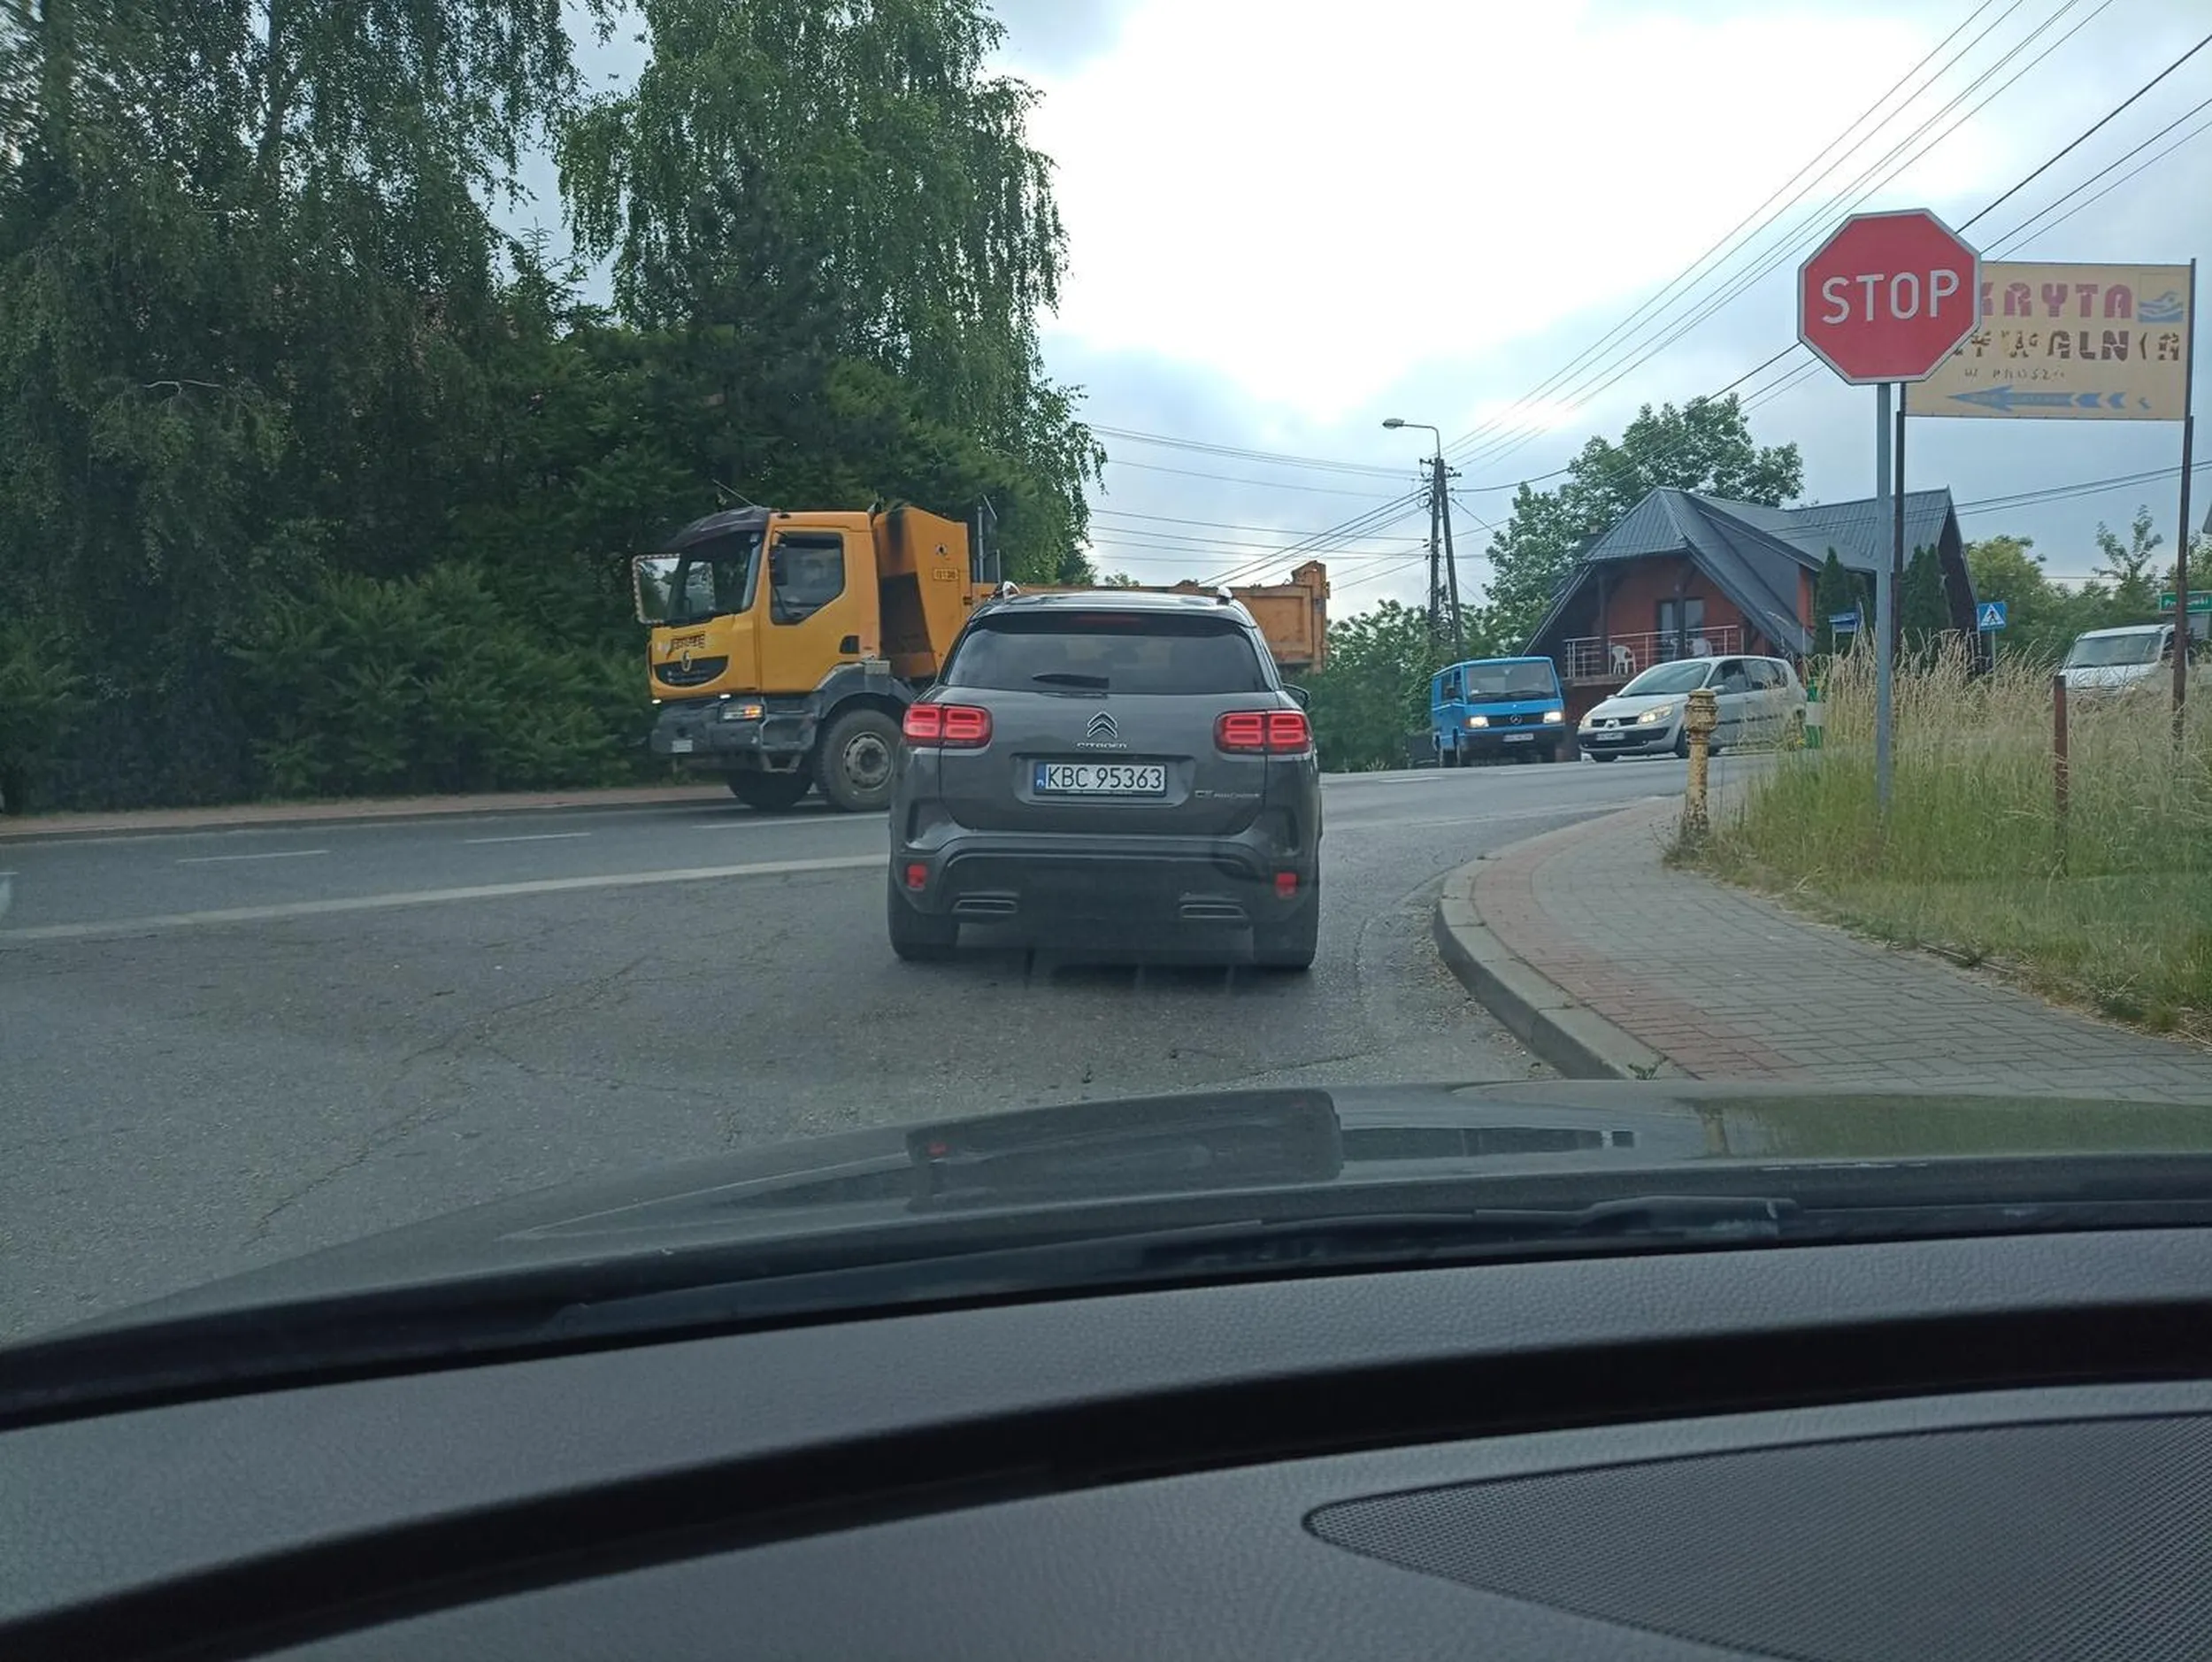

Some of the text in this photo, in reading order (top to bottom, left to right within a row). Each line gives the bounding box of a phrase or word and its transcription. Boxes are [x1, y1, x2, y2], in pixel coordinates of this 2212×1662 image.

[1822, 269, 1960, 325] STOP
[1048, 766, 1163, 789] KBC 95363
